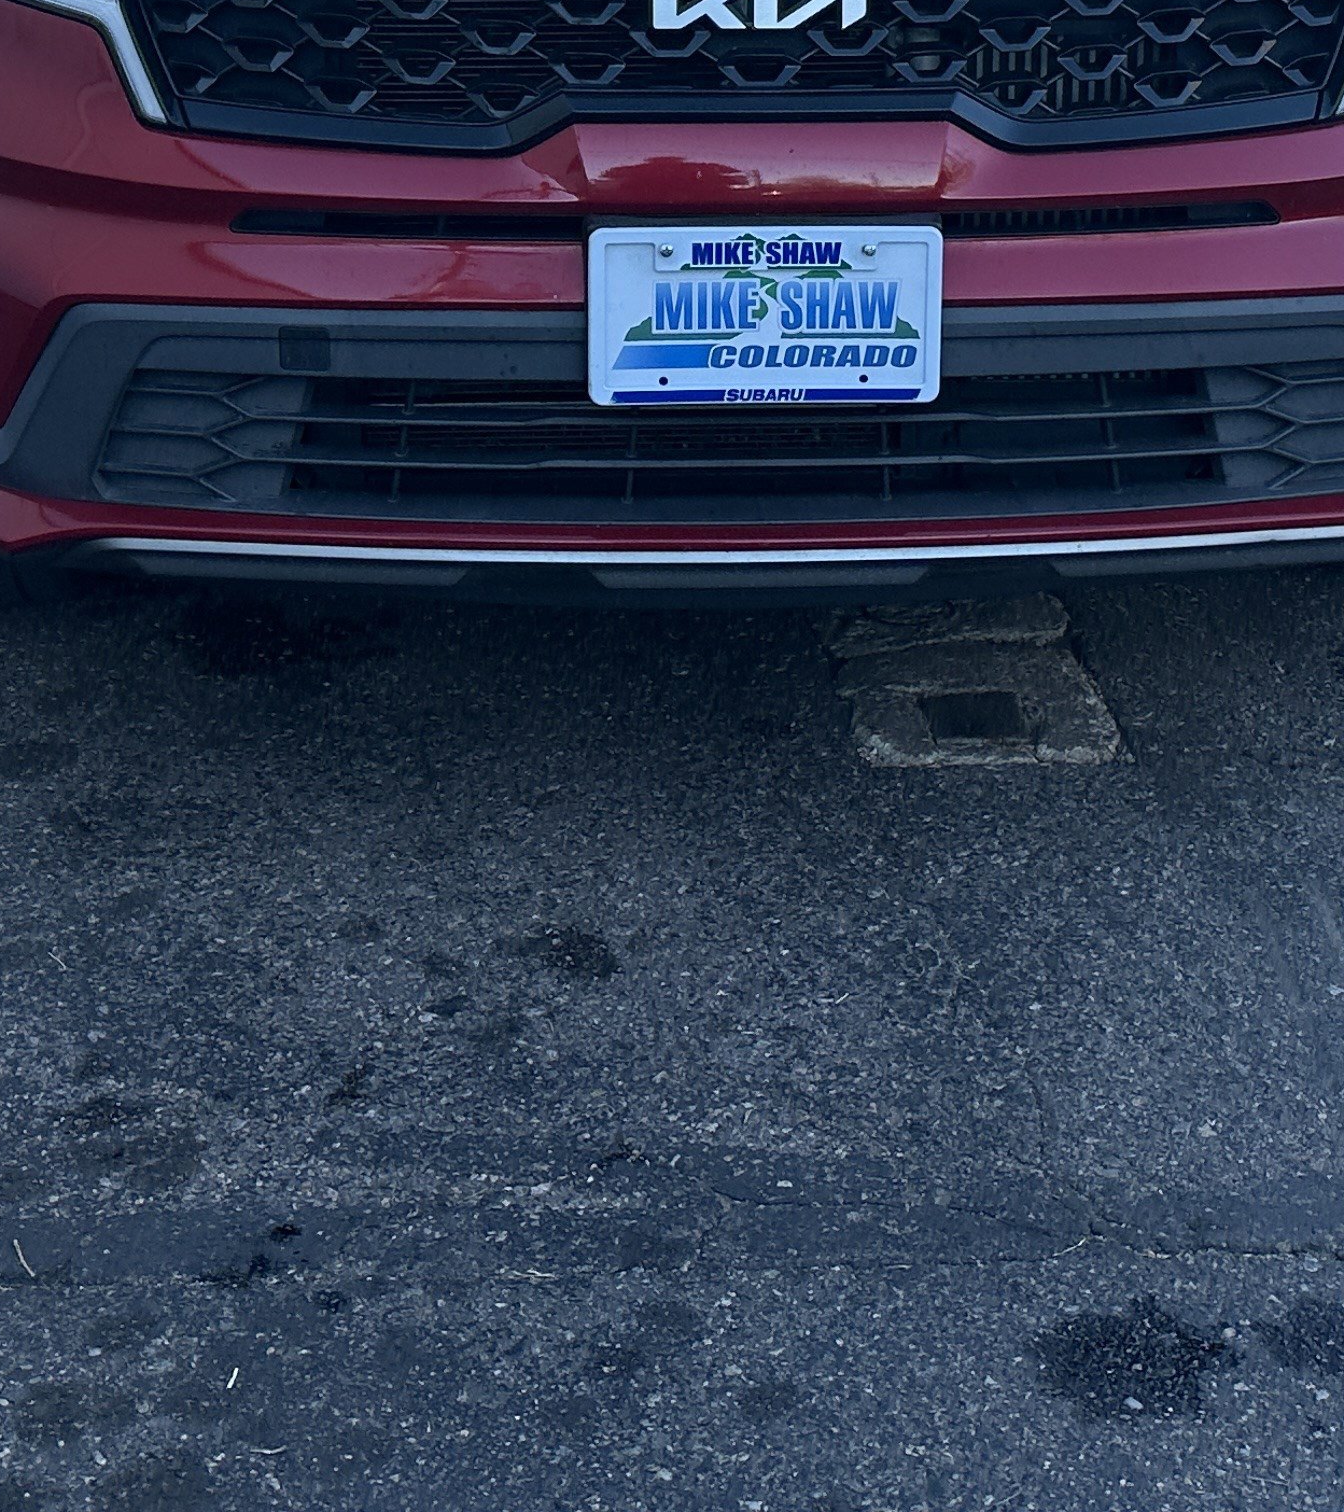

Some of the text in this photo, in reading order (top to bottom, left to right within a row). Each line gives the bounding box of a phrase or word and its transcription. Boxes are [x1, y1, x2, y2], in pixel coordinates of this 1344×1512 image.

[692, 241, 842, 265] MIKE SHAW
[656, 281, 898, 330] MIKE SHAW
[710, 344, 918, 369] COLORADO
[726, 388, 805, 402] SUBARU
